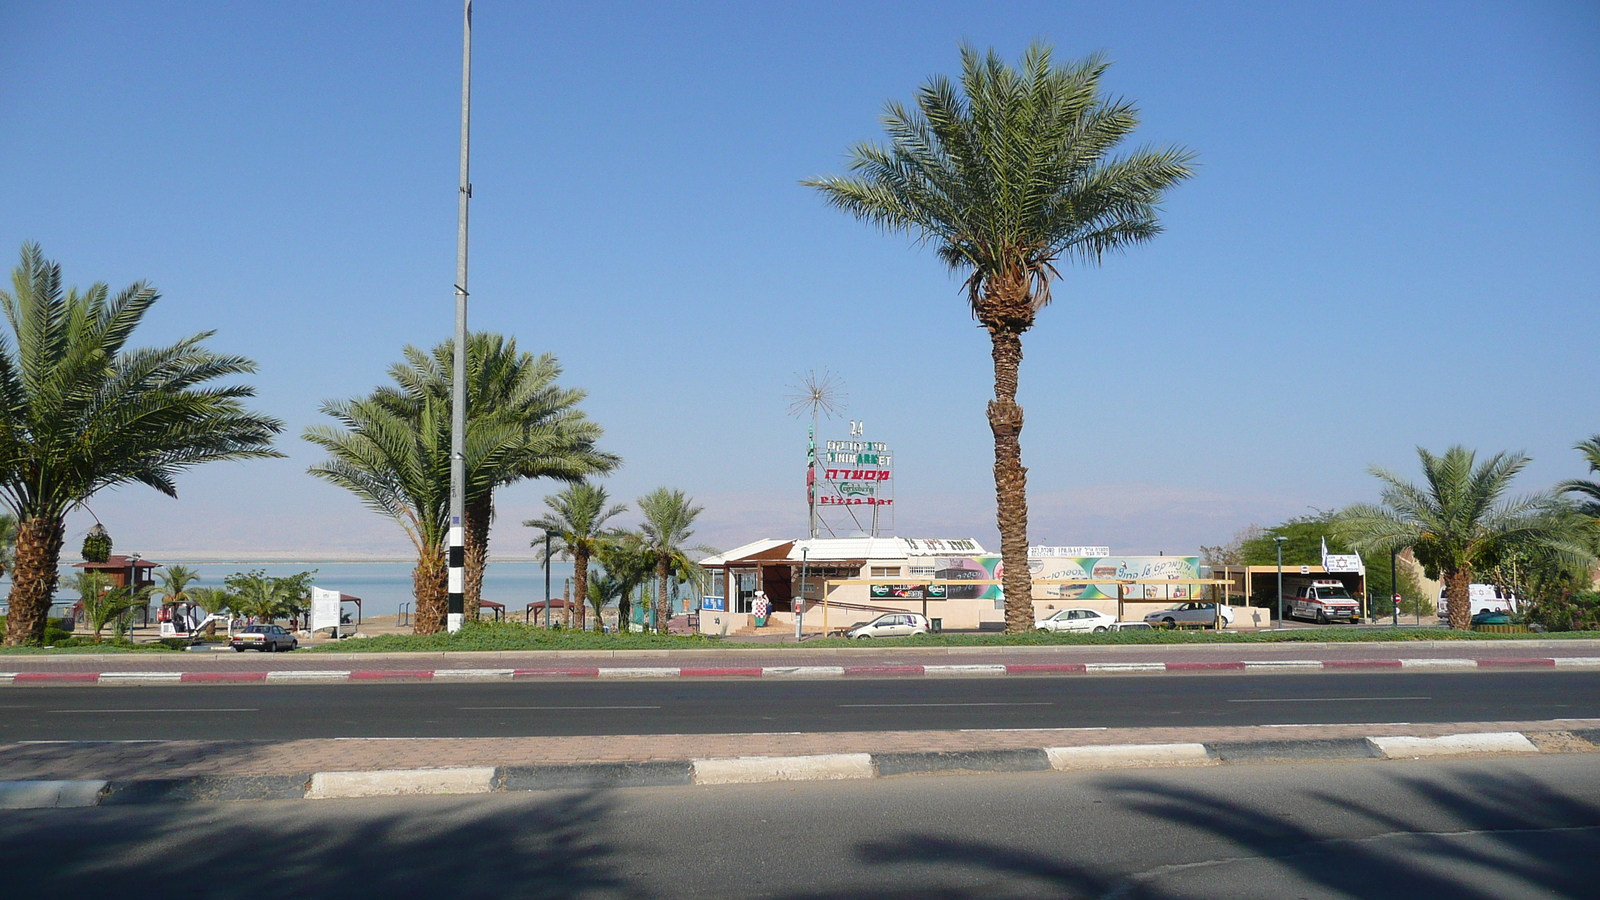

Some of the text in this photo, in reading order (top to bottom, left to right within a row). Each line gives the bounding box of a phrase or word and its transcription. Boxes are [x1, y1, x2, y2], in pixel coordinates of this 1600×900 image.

[850, 420, 863, 435] 24
[826, 452, 892, 466] MINIMARKET
[825, 469, 890, 480] מסעדה
[840, 482, 874, 495] Carlsberg
[820, 496, 893, 505] Pizza Bar
